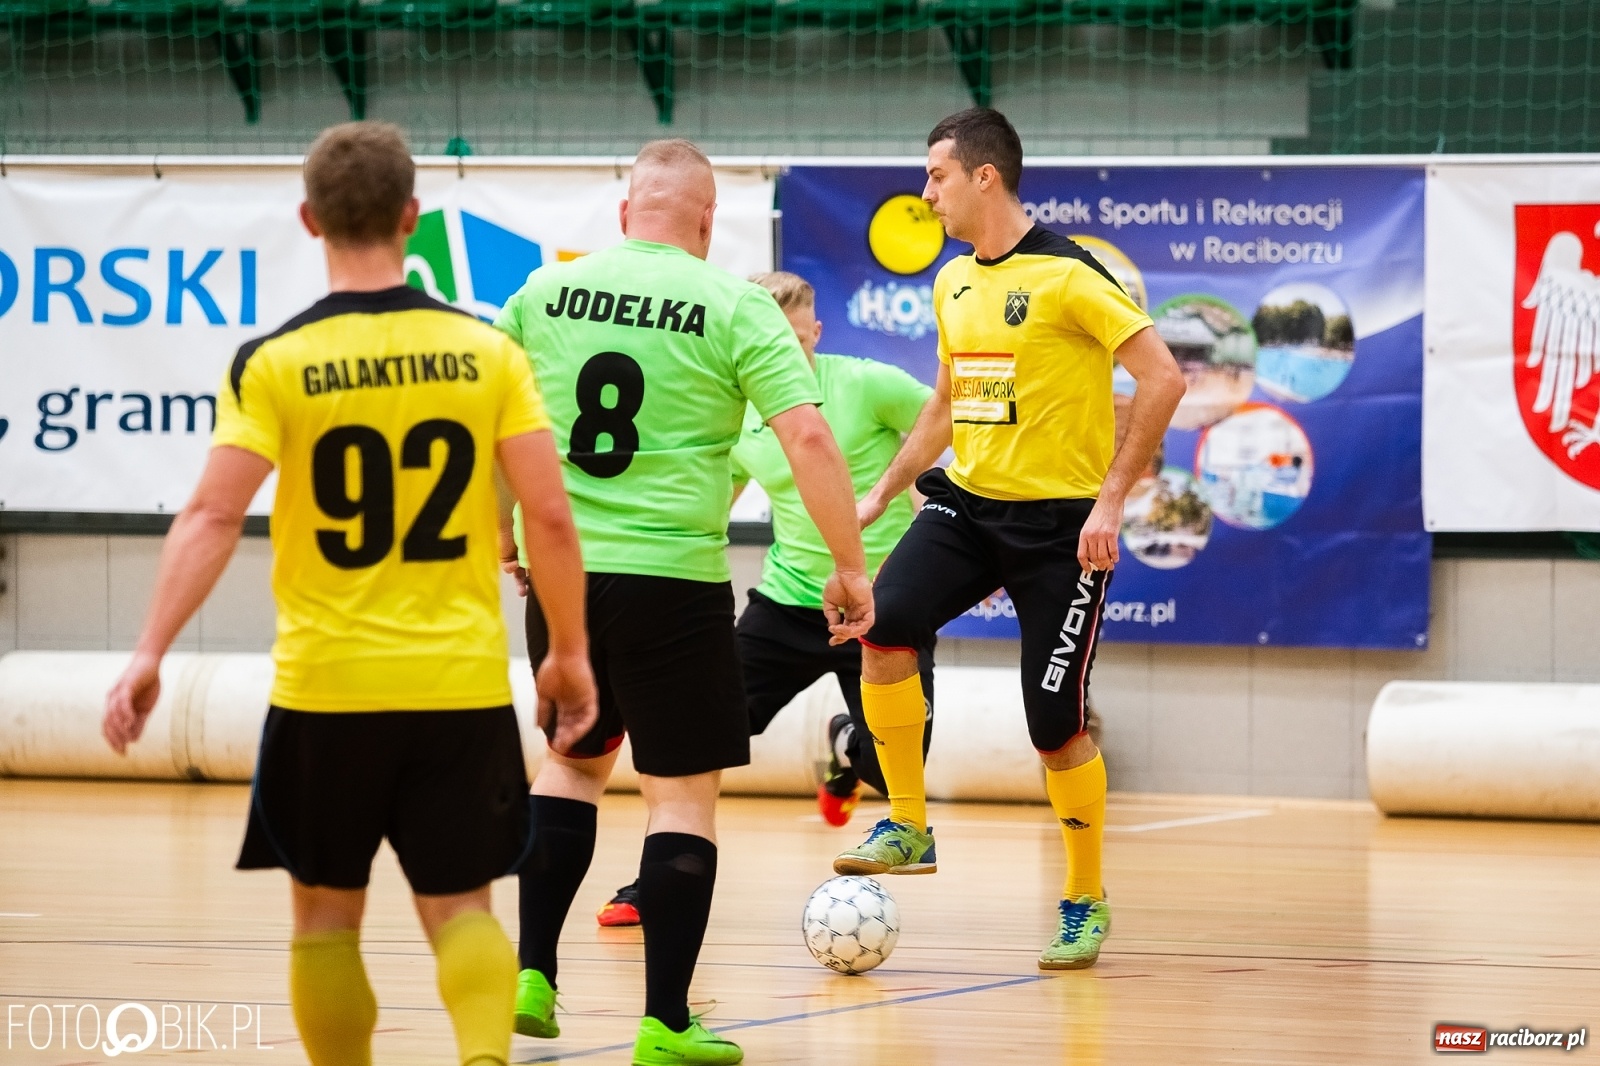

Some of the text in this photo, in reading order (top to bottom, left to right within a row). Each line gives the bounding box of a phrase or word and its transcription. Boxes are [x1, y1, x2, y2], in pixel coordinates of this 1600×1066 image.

[1098, 196, 1190, 230] Sportu
[1196, 199, 1205, 225] i
[1213, 198, 1343, 231] Rekreacji
[1169, 236, 1343, 264] w Raciborzu
[545, 286, 706, 338] JODEŁKA
[303, 353, 479, 396] GALAKTIKOS
[567, 351, 645, 479] 8
[311, 418, 476, 571] 92
[1041, 561, 1099, 693] GIVOVA
